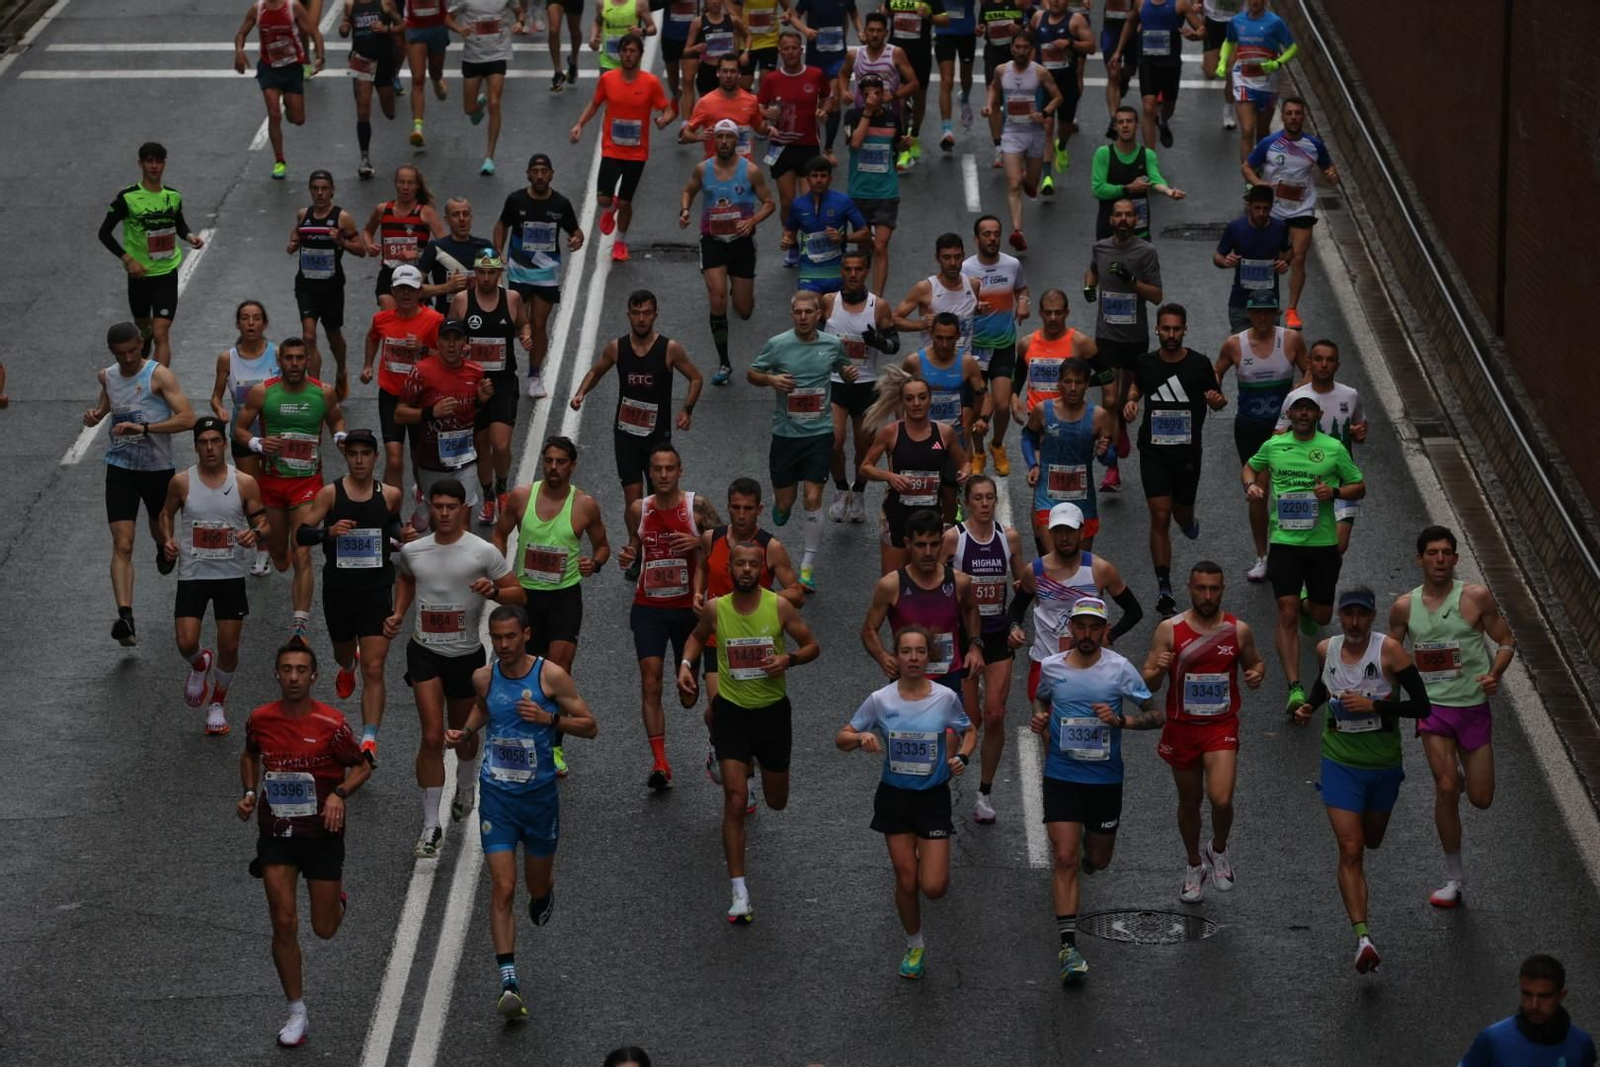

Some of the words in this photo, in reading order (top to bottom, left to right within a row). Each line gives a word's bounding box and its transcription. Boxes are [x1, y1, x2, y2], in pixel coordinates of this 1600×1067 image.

[628, 374, 654, 385] RTC
[1282, 502, 1309, 514] 2290
[343, 539, 371, 551] 3384
[972, 558, 1002, 568] HIGHAM
[976, 586, 996, 598] 513
[1192, 685, 1221, 698] 3343
[1068, 728, 1099, 742] 3334
[498, 748, 526, 762] 3058
[897, 743, 926, 756] 3335
[272, 783, 304, 797] 3396
